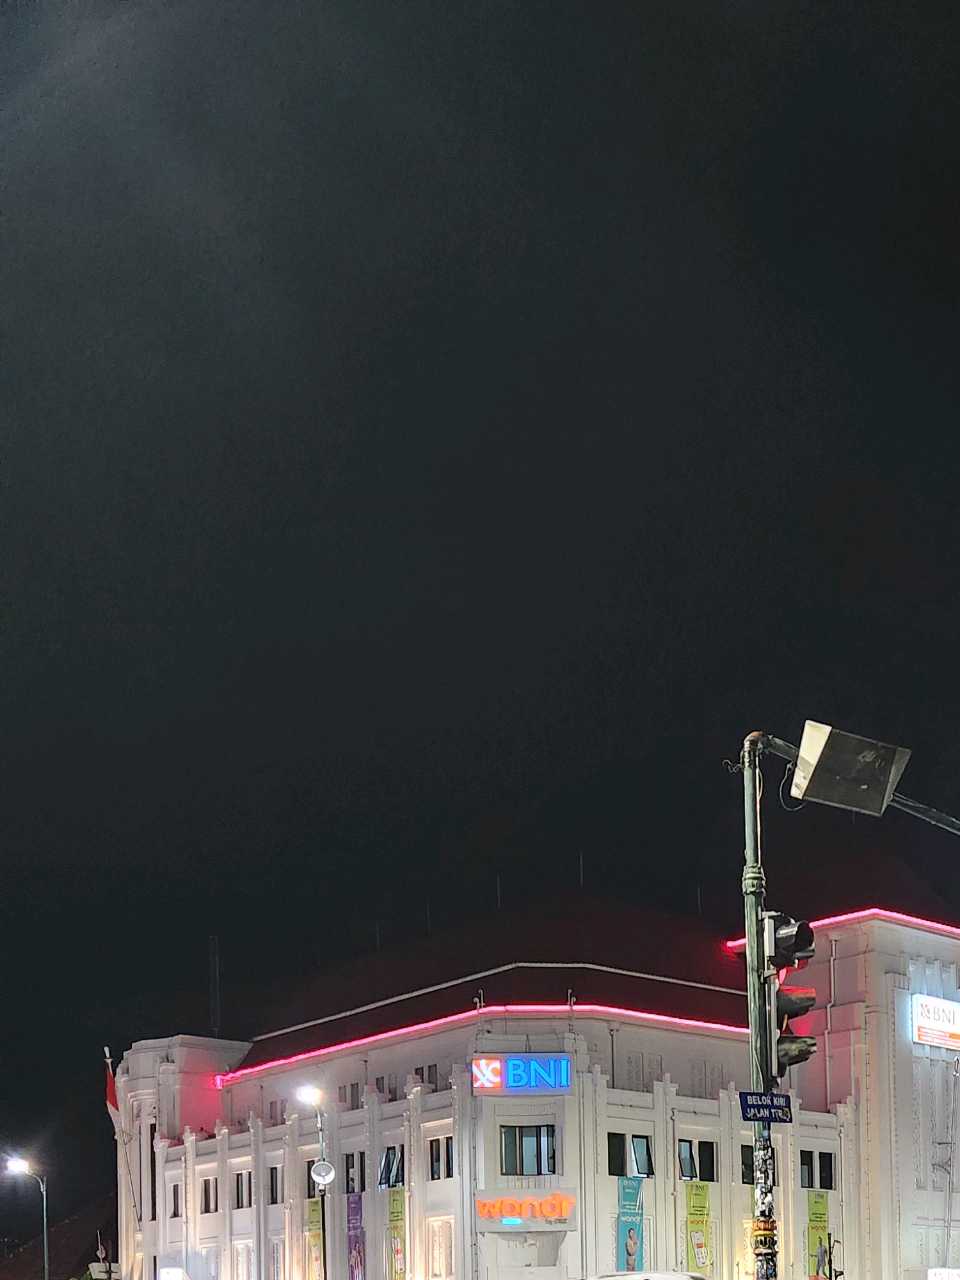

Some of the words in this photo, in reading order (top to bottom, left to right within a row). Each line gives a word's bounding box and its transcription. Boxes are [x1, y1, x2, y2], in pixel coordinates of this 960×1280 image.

[933, 1006, 956, 1025] BNI
[507, 1058, 570, 1088] BNI
[747, 1095, 772, 1106] BELOK
[773, 1097, 786, 1107] KIRI
[745, 1107, 770, 1119] JALAN
